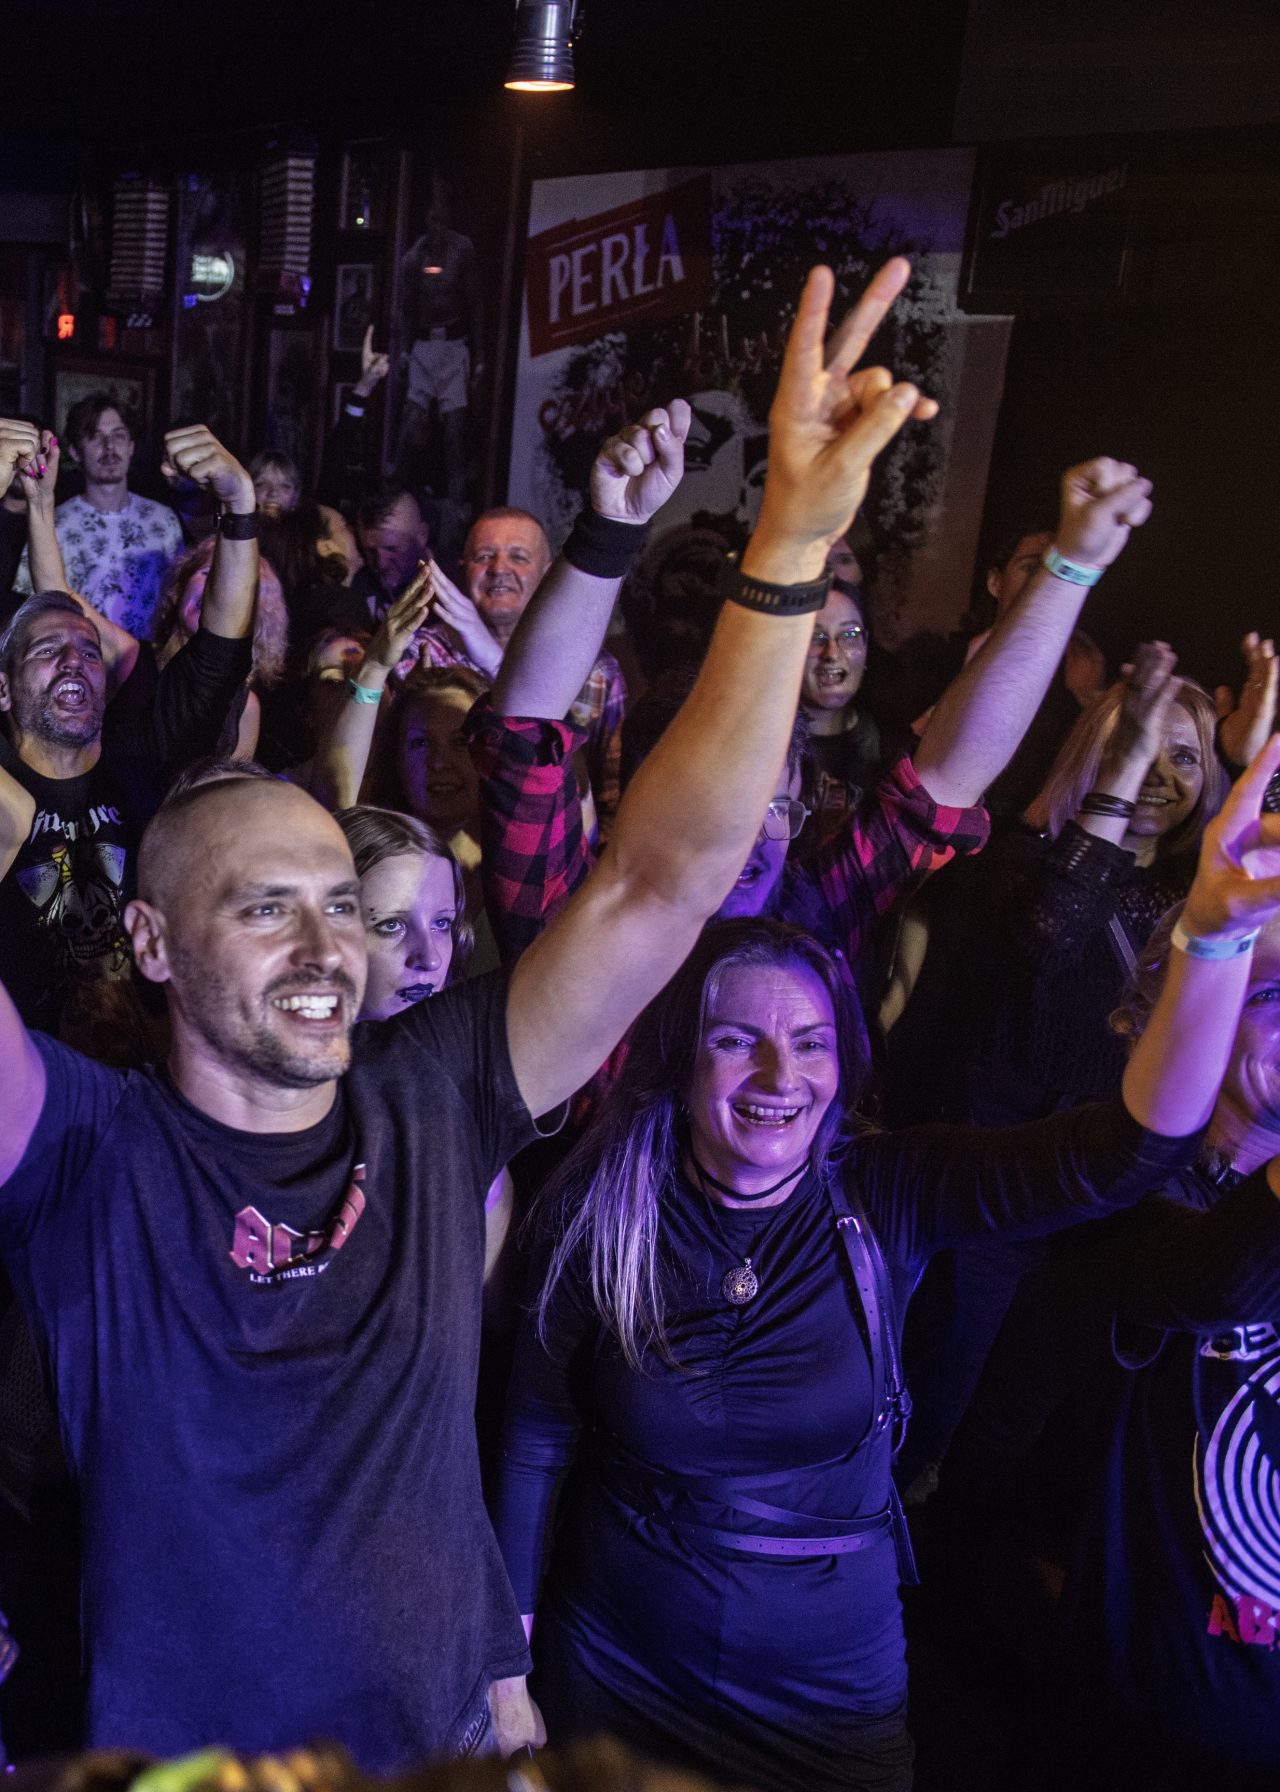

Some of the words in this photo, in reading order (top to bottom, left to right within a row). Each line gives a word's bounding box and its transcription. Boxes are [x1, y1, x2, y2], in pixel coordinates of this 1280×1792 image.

[548, 212, 686, 325] PERŁA
[250, 1273, 273, 1284] LET
[277, 1262, 316, 1281] THERE
[1206, 1592, 1280, 1653] AB
